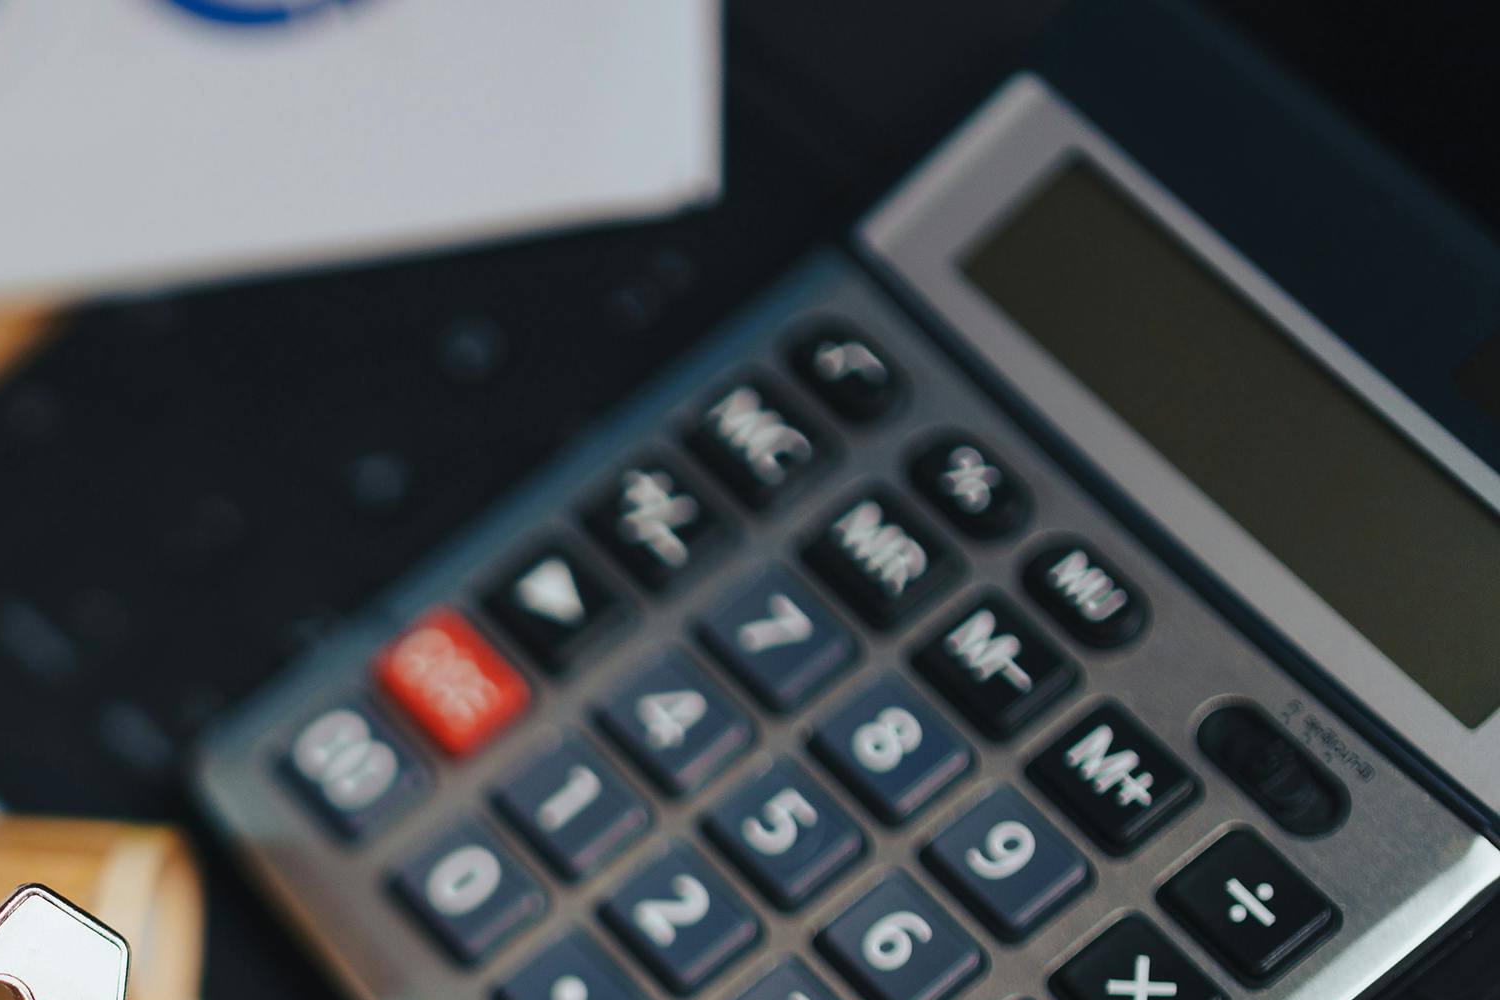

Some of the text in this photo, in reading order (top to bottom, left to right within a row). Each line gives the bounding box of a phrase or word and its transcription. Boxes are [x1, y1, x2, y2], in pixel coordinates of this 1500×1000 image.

[707, 386, 813, 485] MC
[832, 500, 929, 594] MR
[1050, 549, 1129, 621] MU
[739, 595, 812, 651] 7
[639, 691, 706, 747] 4
[853, 708, 922, 771] 8
[292, 710, 398, 812] 00
[1066, 723, 1156, 808] M+
[538, 766, 600, 830] 1
[744, 789, 817, 854] 5
[427, 846, 501, 914] 0
[968, 821, 1035, 879] 9
[635, 875, 709, 945] 2
[863, 911, 932, 970] 6
